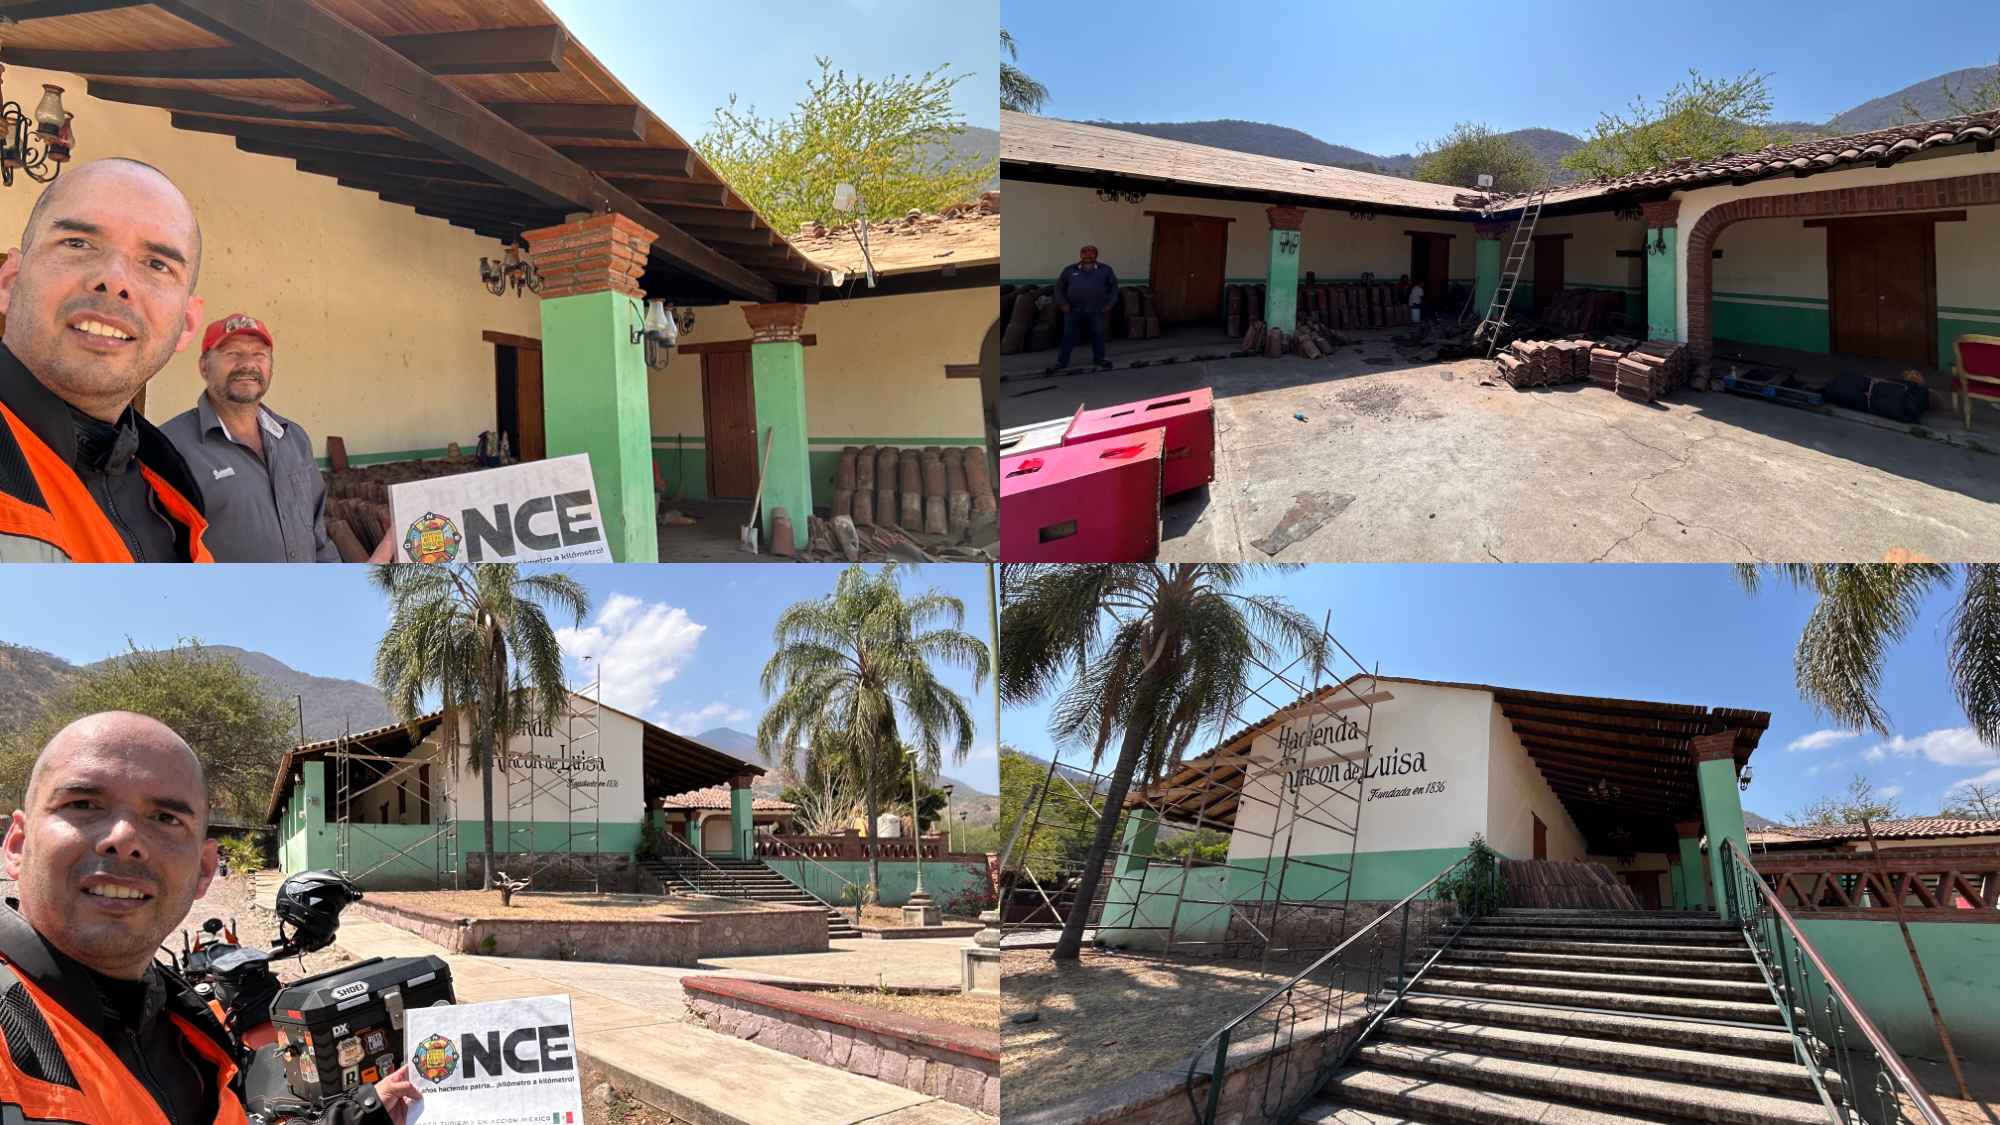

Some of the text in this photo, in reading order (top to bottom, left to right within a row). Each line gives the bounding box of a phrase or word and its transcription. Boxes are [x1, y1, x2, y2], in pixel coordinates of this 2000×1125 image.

[561, 547, 604, 561] kilómetro!
[1277, 715, 1359, 758] Hacienda
[557, 744, 607, 773] Luisa
[1343, 763, 1360, 781] de
[1357, 744, 1427, 785] Luisa
[606, 779, 619, 788] 1836
[1367, 781, 1446, 802] Fundada en 1836
[336, 984, 365, 997] SHOEI
[332, 1022, 349, 1036] DX
[438, 1084, 469, 1093] haciendo
[496, 1079, 532, 1089] ¡kilómetro
[538, 1076, 575, 1085] kilómetro!
